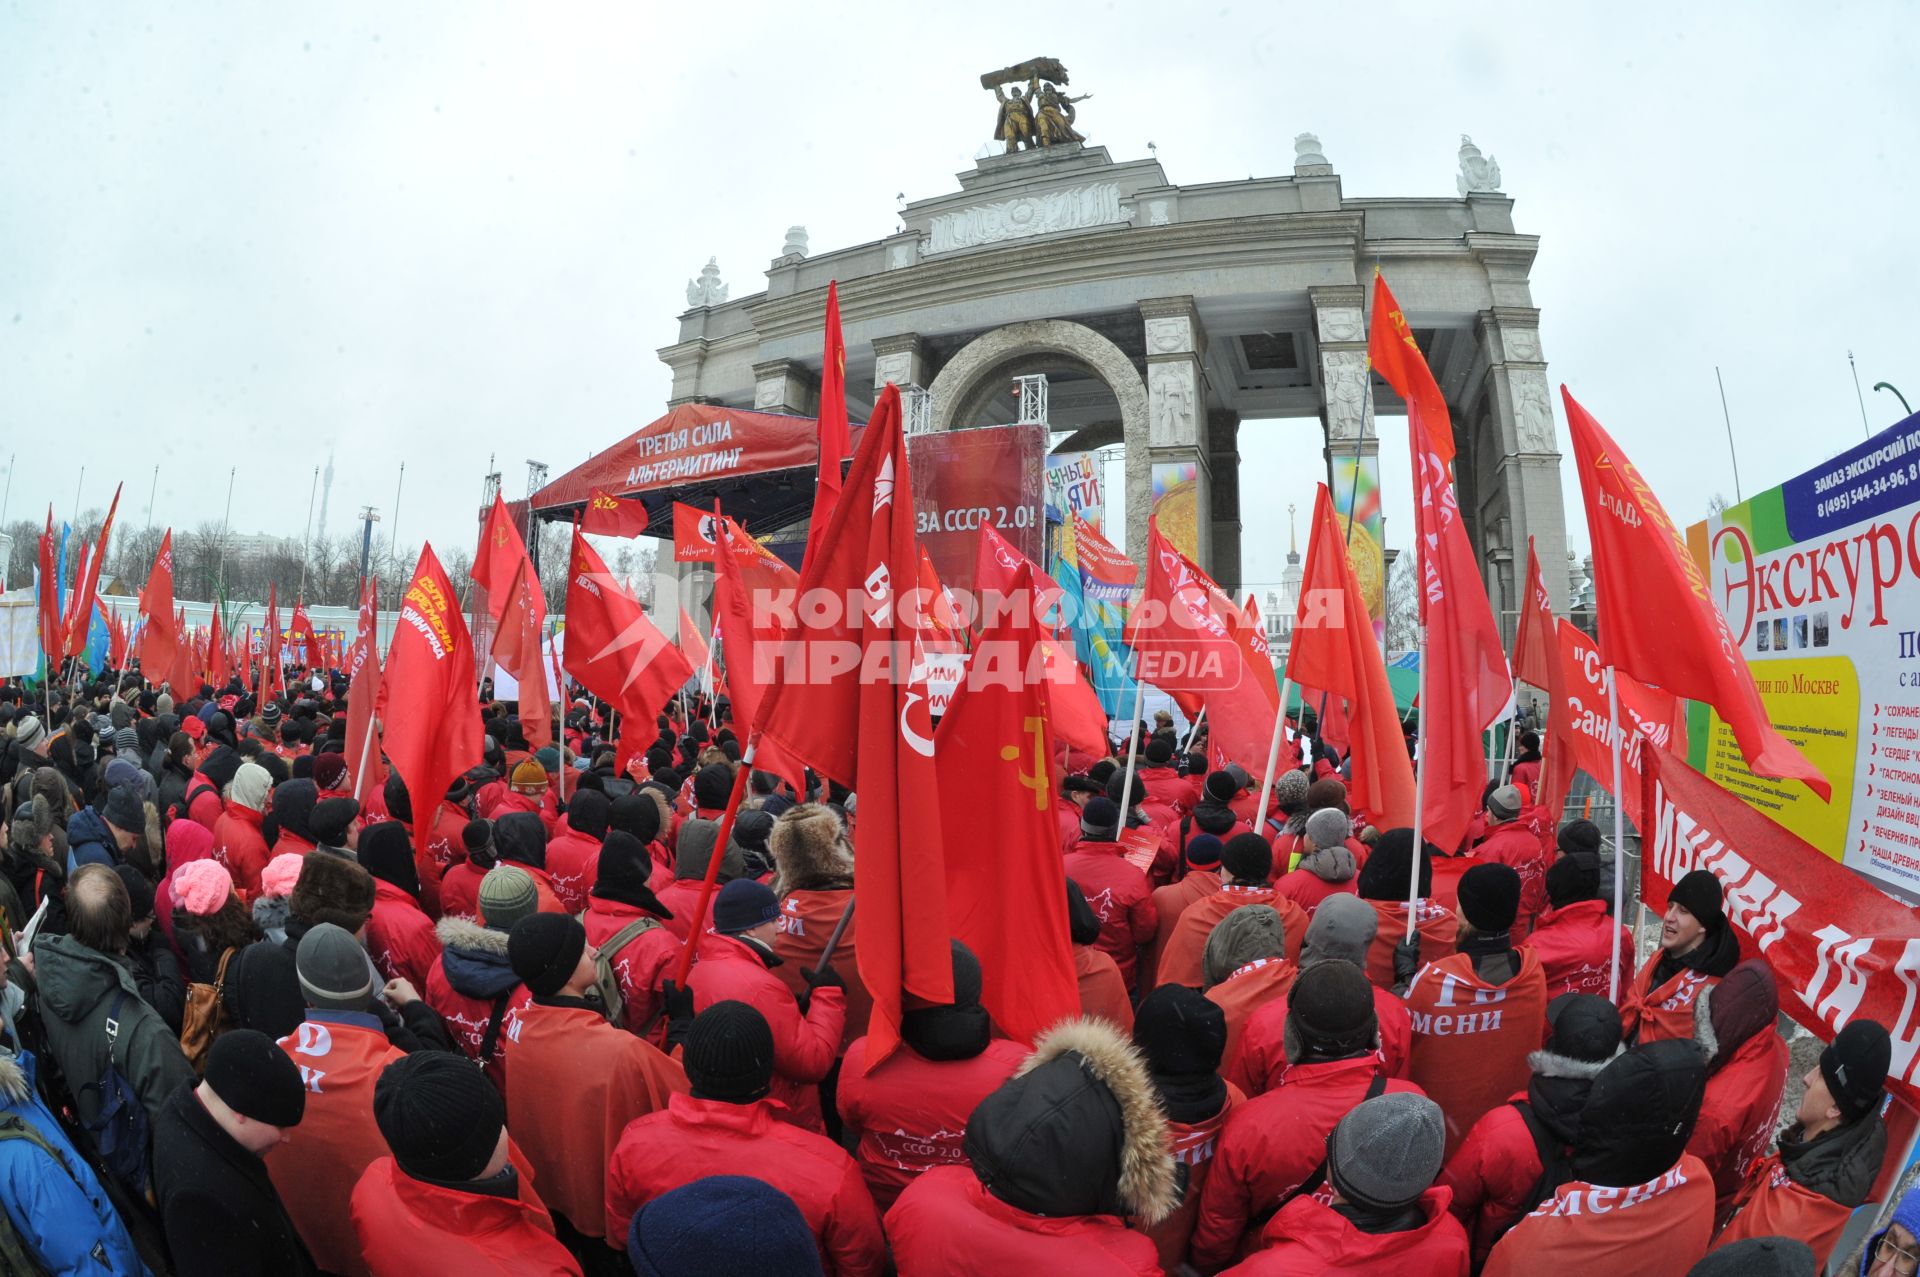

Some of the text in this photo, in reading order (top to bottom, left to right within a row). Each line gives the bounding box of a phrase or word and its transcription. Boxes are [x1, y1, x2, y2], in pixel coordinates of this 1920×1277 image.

[637, 419, 732, 458] ТРЕТЬЯ СИЛА
[626, 447, 743, 486] АЛЬТЕРМИТИНГ
[1814, 468, 1845, 494] ЗАКАЗ
[1845, 434, 1906, 480] ЭКСКУРСИЙ
[916, 505, 1036, 534] ЗА СССР 2.0!
[1817, 503, 1825, 518] 8
[1825, 491, 1850, 518] (495)
[401, 605, 446, 660] ЕНИНГРАД
[406, 587, 454, 653] ВРЕМЕНИ
[1792, 673, 1840, 694] Москве
[1876, 805, 1905, 822] ДИЗАЙН
[1405, 1006, 1504, 1036] мени
[902, 1142, 961, 1159] СССР 2.0
